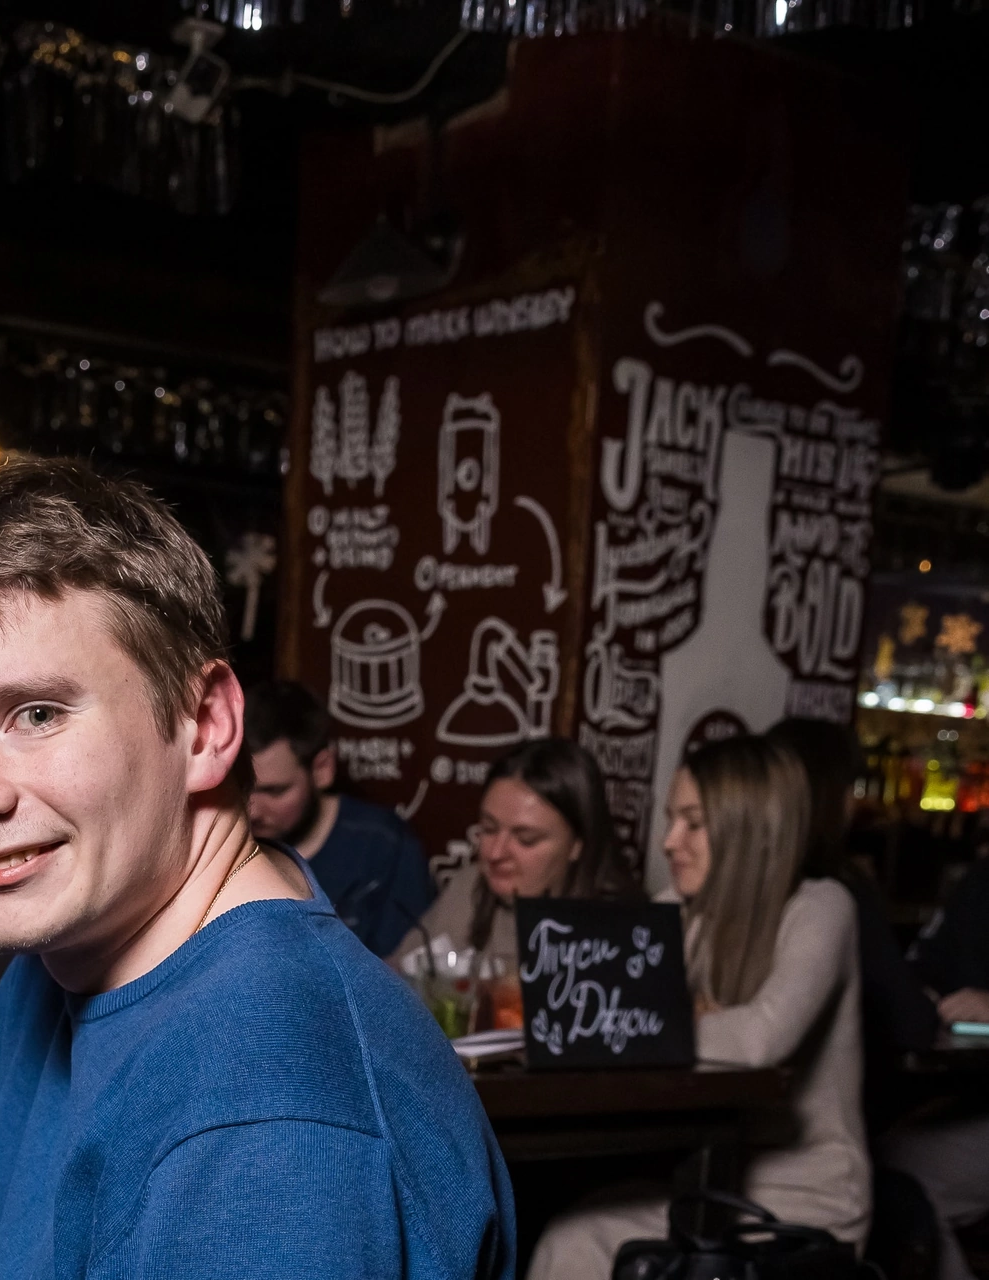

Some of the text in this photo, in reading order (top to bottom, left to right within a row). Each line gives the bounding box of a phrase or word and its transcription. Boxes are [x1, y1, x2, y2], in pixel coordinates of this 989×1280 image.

[314, 325, 371, 362] HOW
[374, 318, 401, 350] TO
[600, 358, 726, 511] JACK
[769, 555, 863, 683] BOLD
